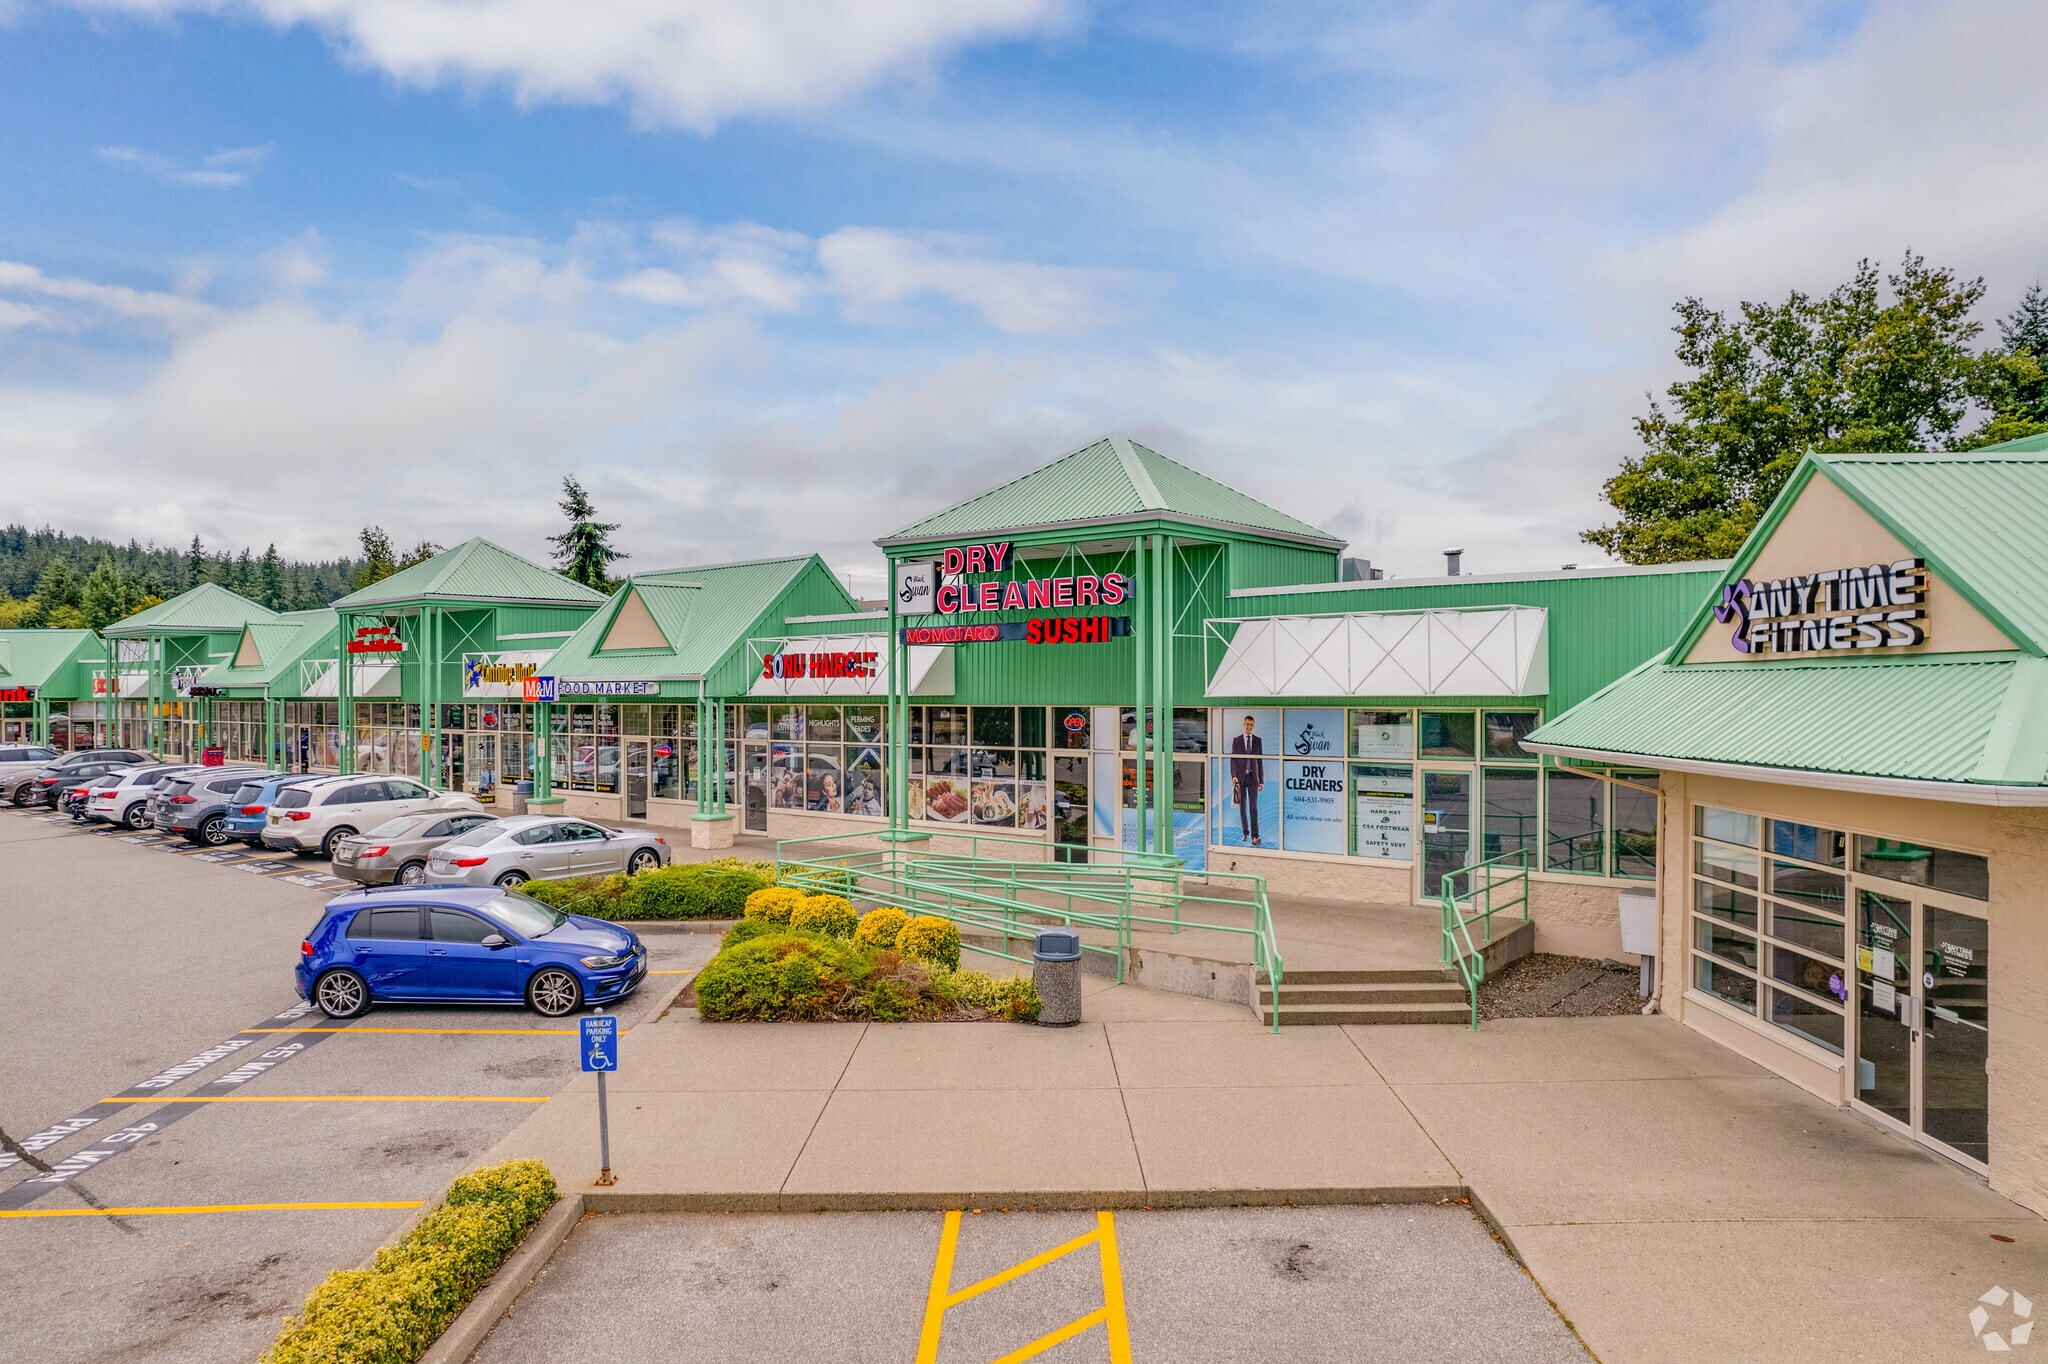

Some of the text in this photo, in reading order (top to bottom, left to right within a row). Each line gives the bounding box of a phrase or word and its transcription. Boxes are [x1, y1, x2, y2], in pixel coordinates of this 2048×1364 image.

[944, 542, 1011, 576] DRY
[900, 576, 931, 602] Swan
[937, 572, 1124, 614] CLEANERS
[1750, 558, 1920, 620] ANYTIME
[906, 624, 999, 644] MOMOTARO
[1026, 616, 1110, 645] SUSHI
[1751, 610, 1921, 654] FITNESS
[482, 663, 536, 687] Cartridge World
[763, 652, 878, 679] SONU HAIRCUT
[525, 680, 554, 698] M&M
[558, 681, 649, 695] FOOD MARKET
[809, 719, 840, 727] HIGHLIGHTS
[850, 715, 875, 723] PERMING
[1066, 717, 1085, 728] OPEN
[1295, 729, 1331, 755] Swan
[1302, 766, 1326, 778] DRY
[1286, 778, 1343, 792] CLEANERS
[585, 1019, 612, 1027] HANDICAP
[585, 1028, 612, 1036] PARKING
[591, 1035, 607, 1043] ONLY
[135, 1039, 254, 1089] PARKING
[213, 1042, 305, 1084] 45 MIN
[25, 1121, 159, 1183] 45 MIN
